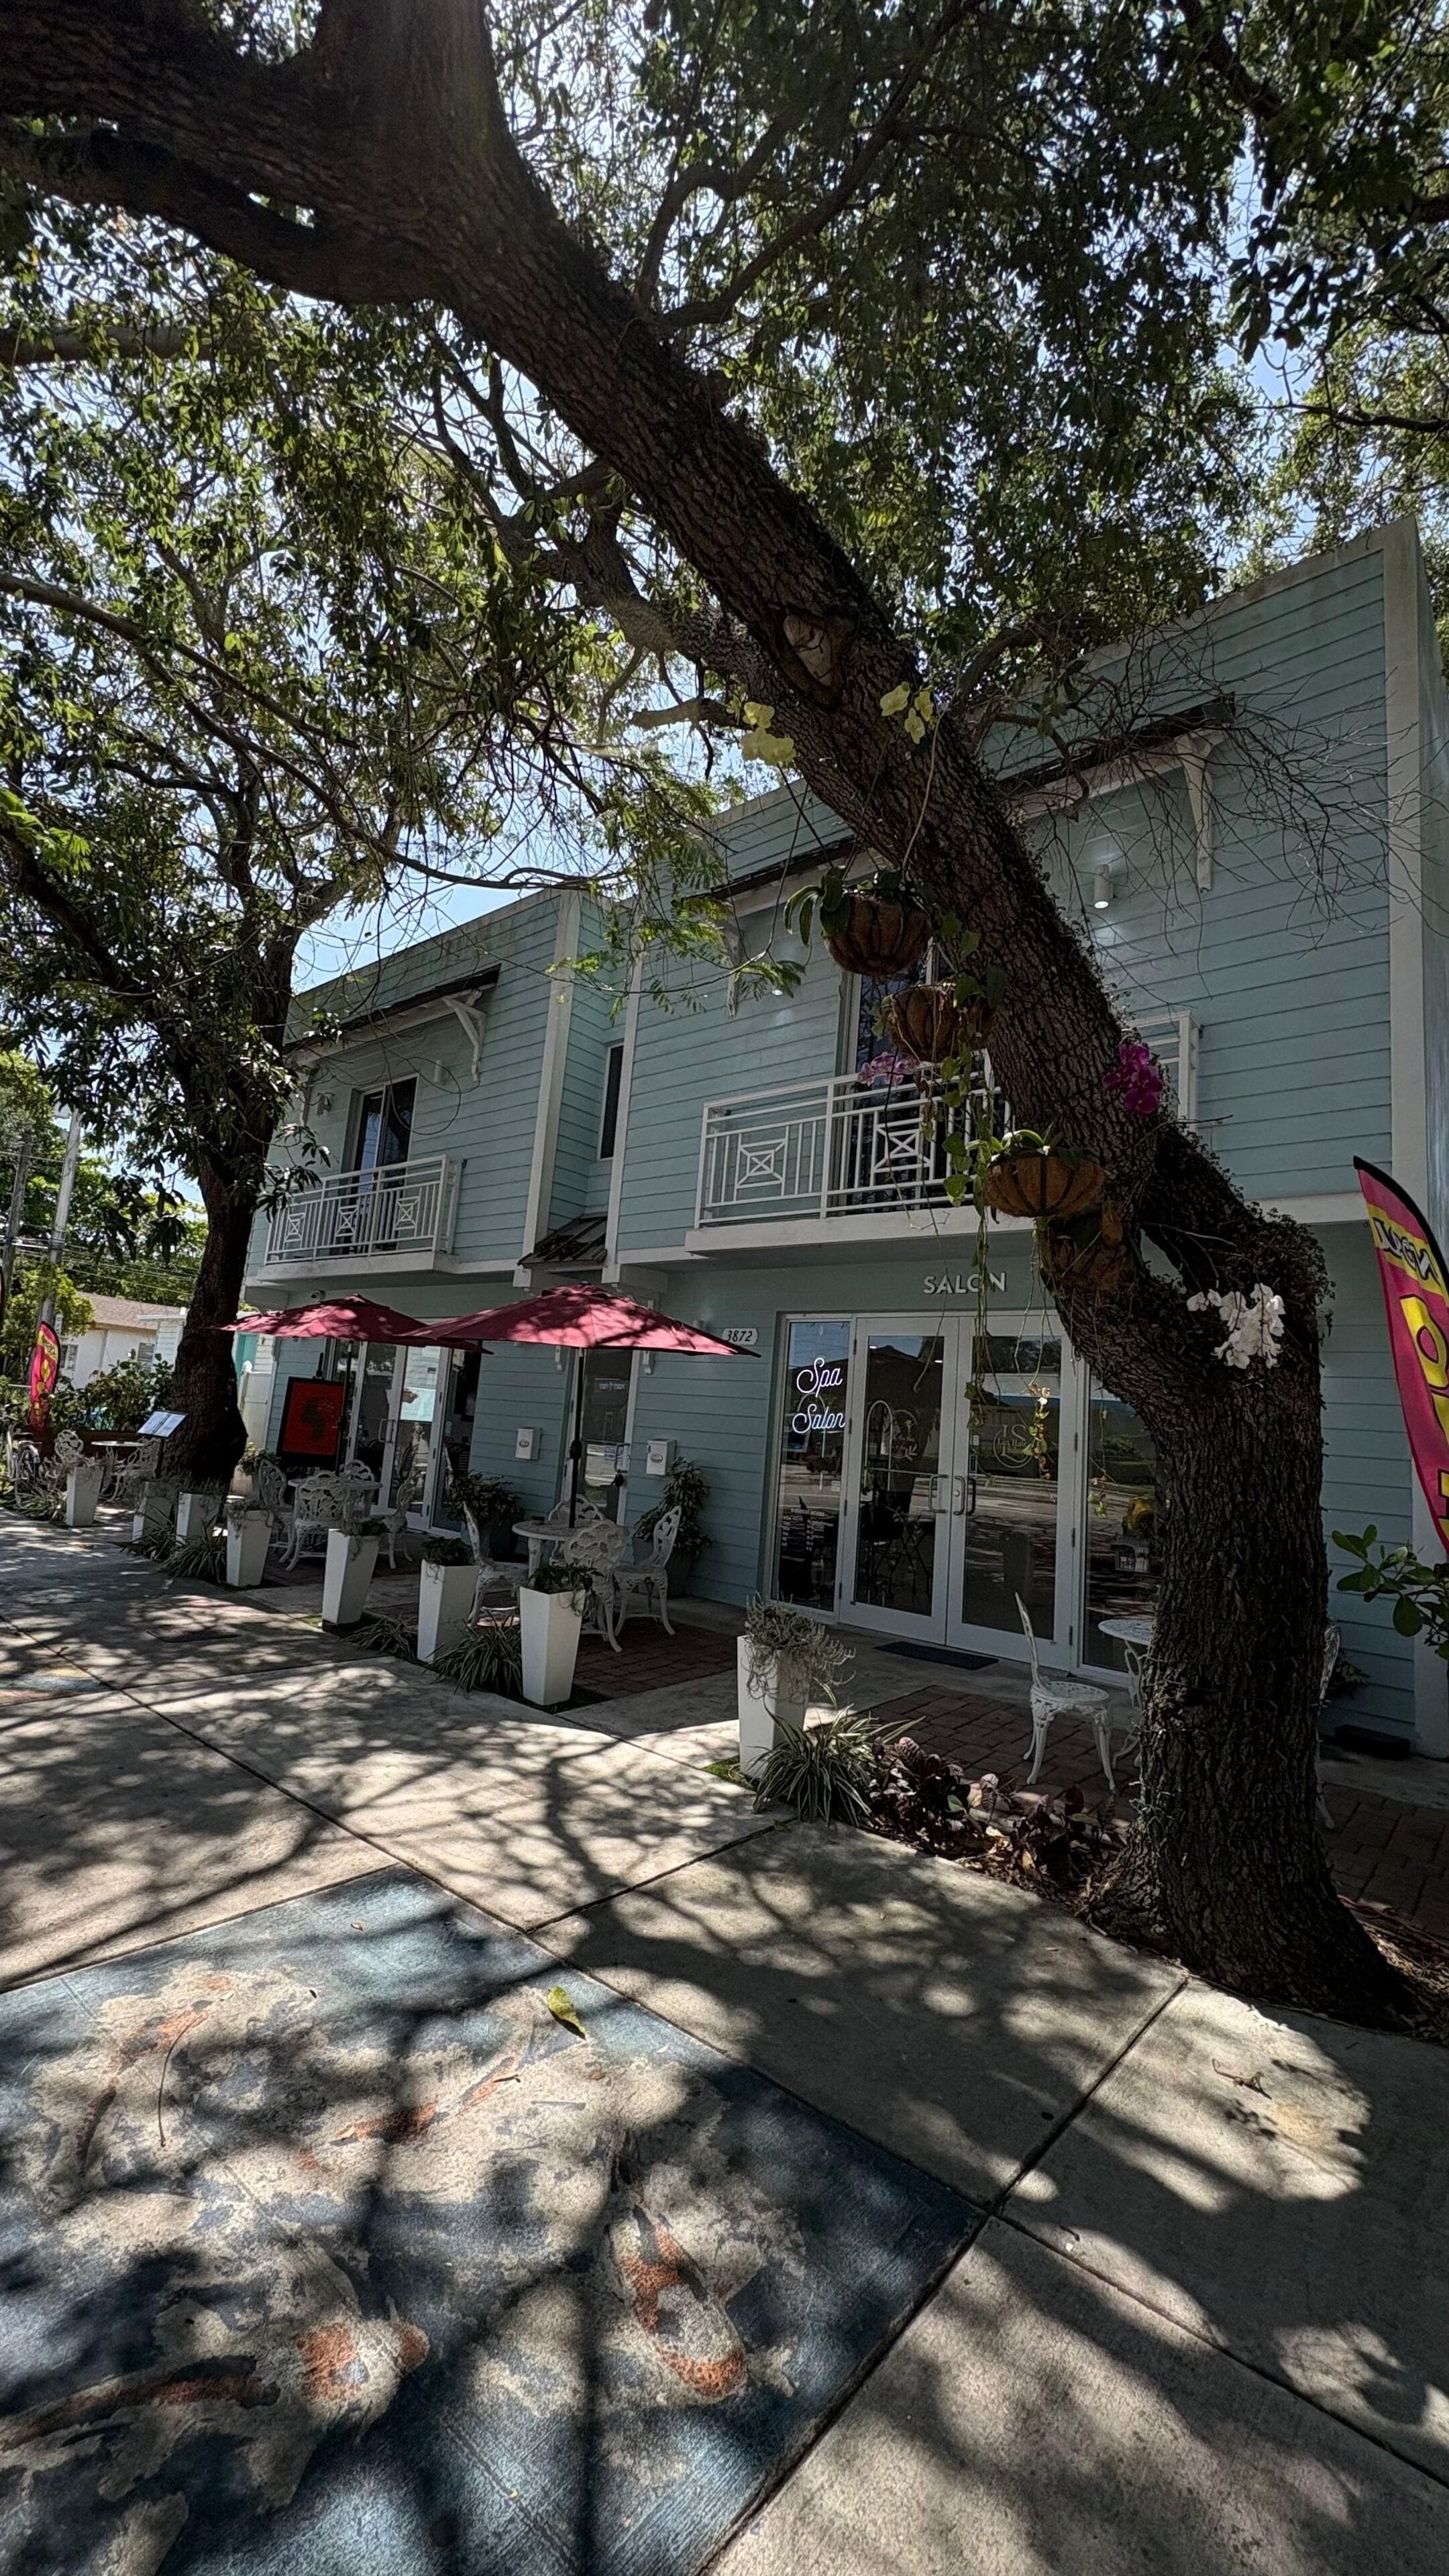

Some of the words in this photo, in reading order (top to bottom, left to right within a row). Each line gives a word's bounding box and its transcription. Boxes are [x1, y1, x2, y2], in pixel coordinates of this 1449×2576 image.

[923, 1272, 1006, 1294] SALON
[724, 1330, 753, 1342] 3872
[796, 1357, 843, 1398] Spa
[792, 1403, 846, 1434] Salon
